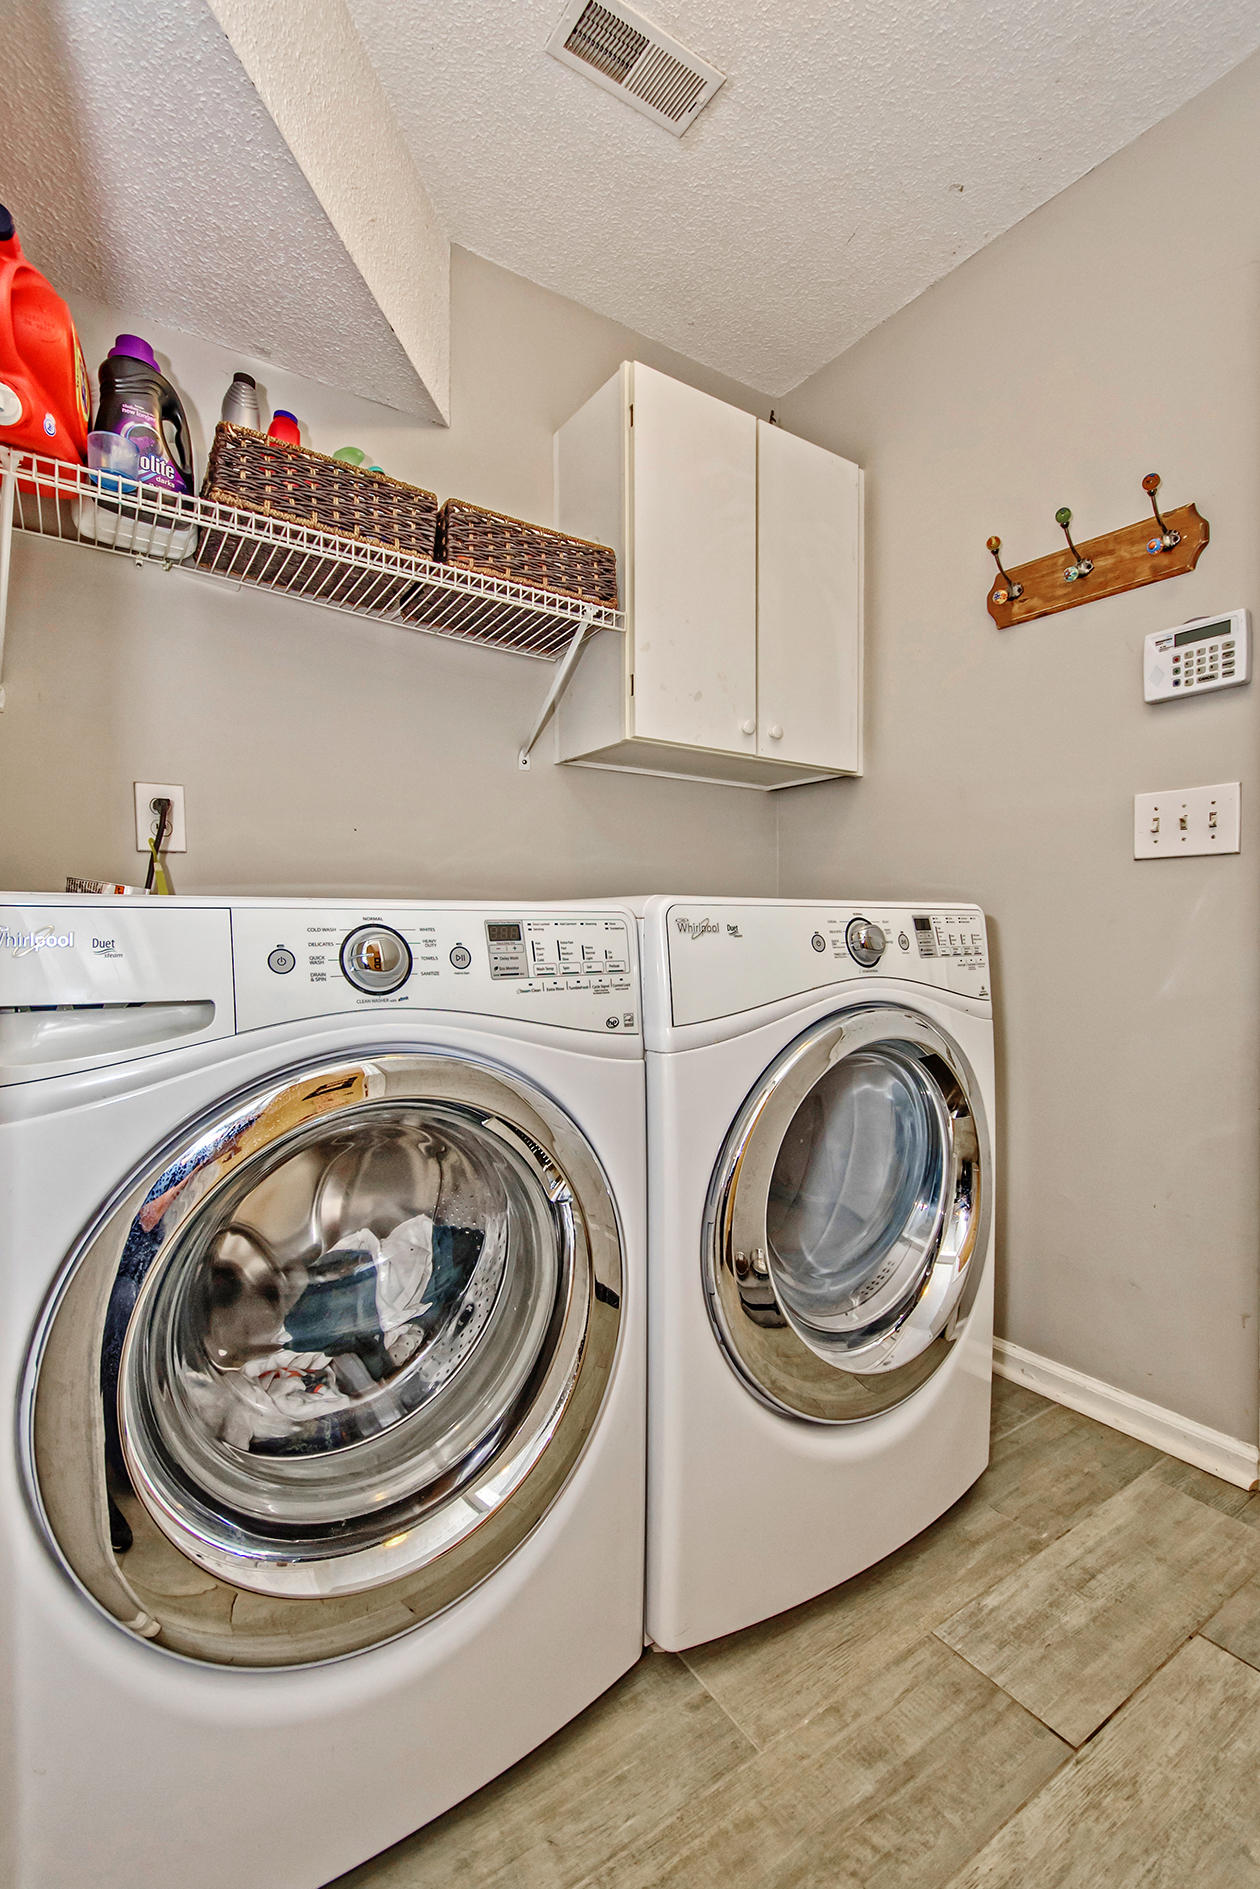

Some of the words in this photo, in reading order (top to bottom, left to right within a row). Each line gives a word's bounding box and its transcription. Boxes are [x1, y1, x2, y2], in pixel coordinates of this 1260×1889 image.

[140, 454, 175, 480] olite
[155, 476, 176, 489] darks
[677, 922, 720, 935] Whirlpool
[92, 937, 116, 949] Duet
